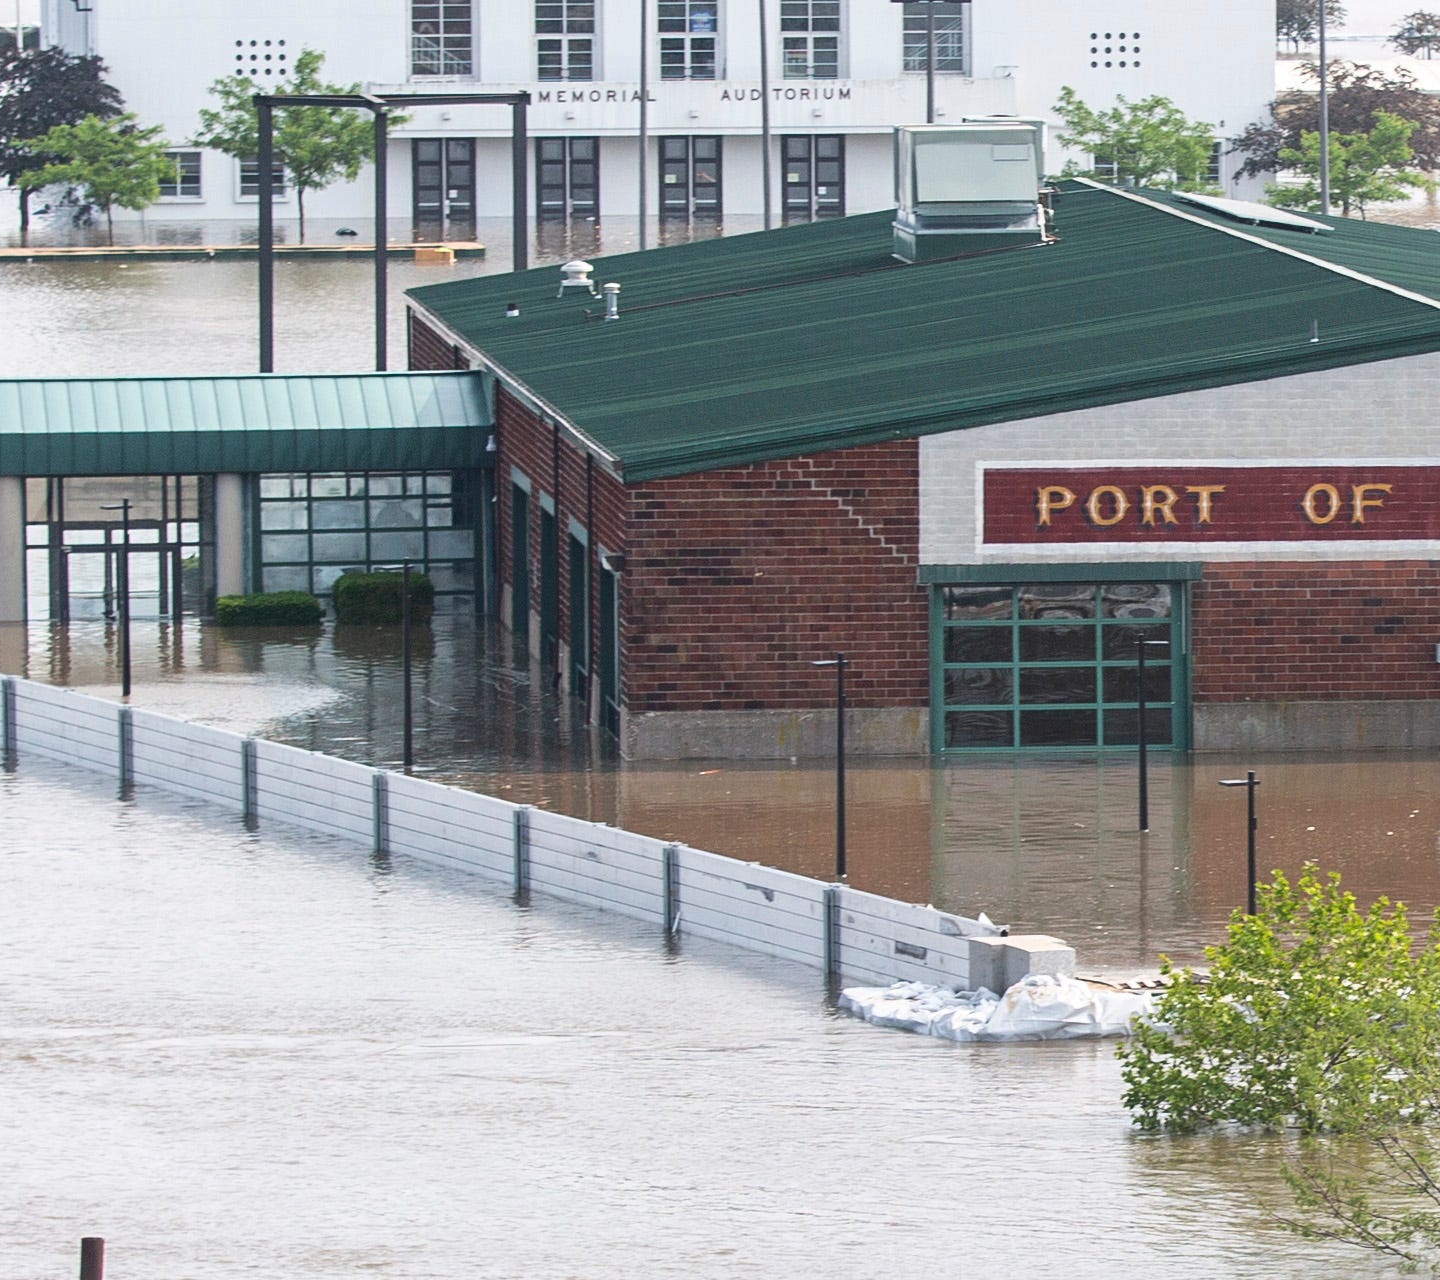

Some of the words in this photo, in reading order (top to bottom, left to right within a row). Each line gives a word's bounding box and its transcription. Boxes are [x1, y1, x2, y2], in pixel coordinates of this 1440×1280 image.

[538, 90, 657, 103] MEMORIAL
[720, 88, 852, 101] AUDTORIUM
[1036, 483, 1226, 527] PORT
[1300, 482, 1393, 525] OF
